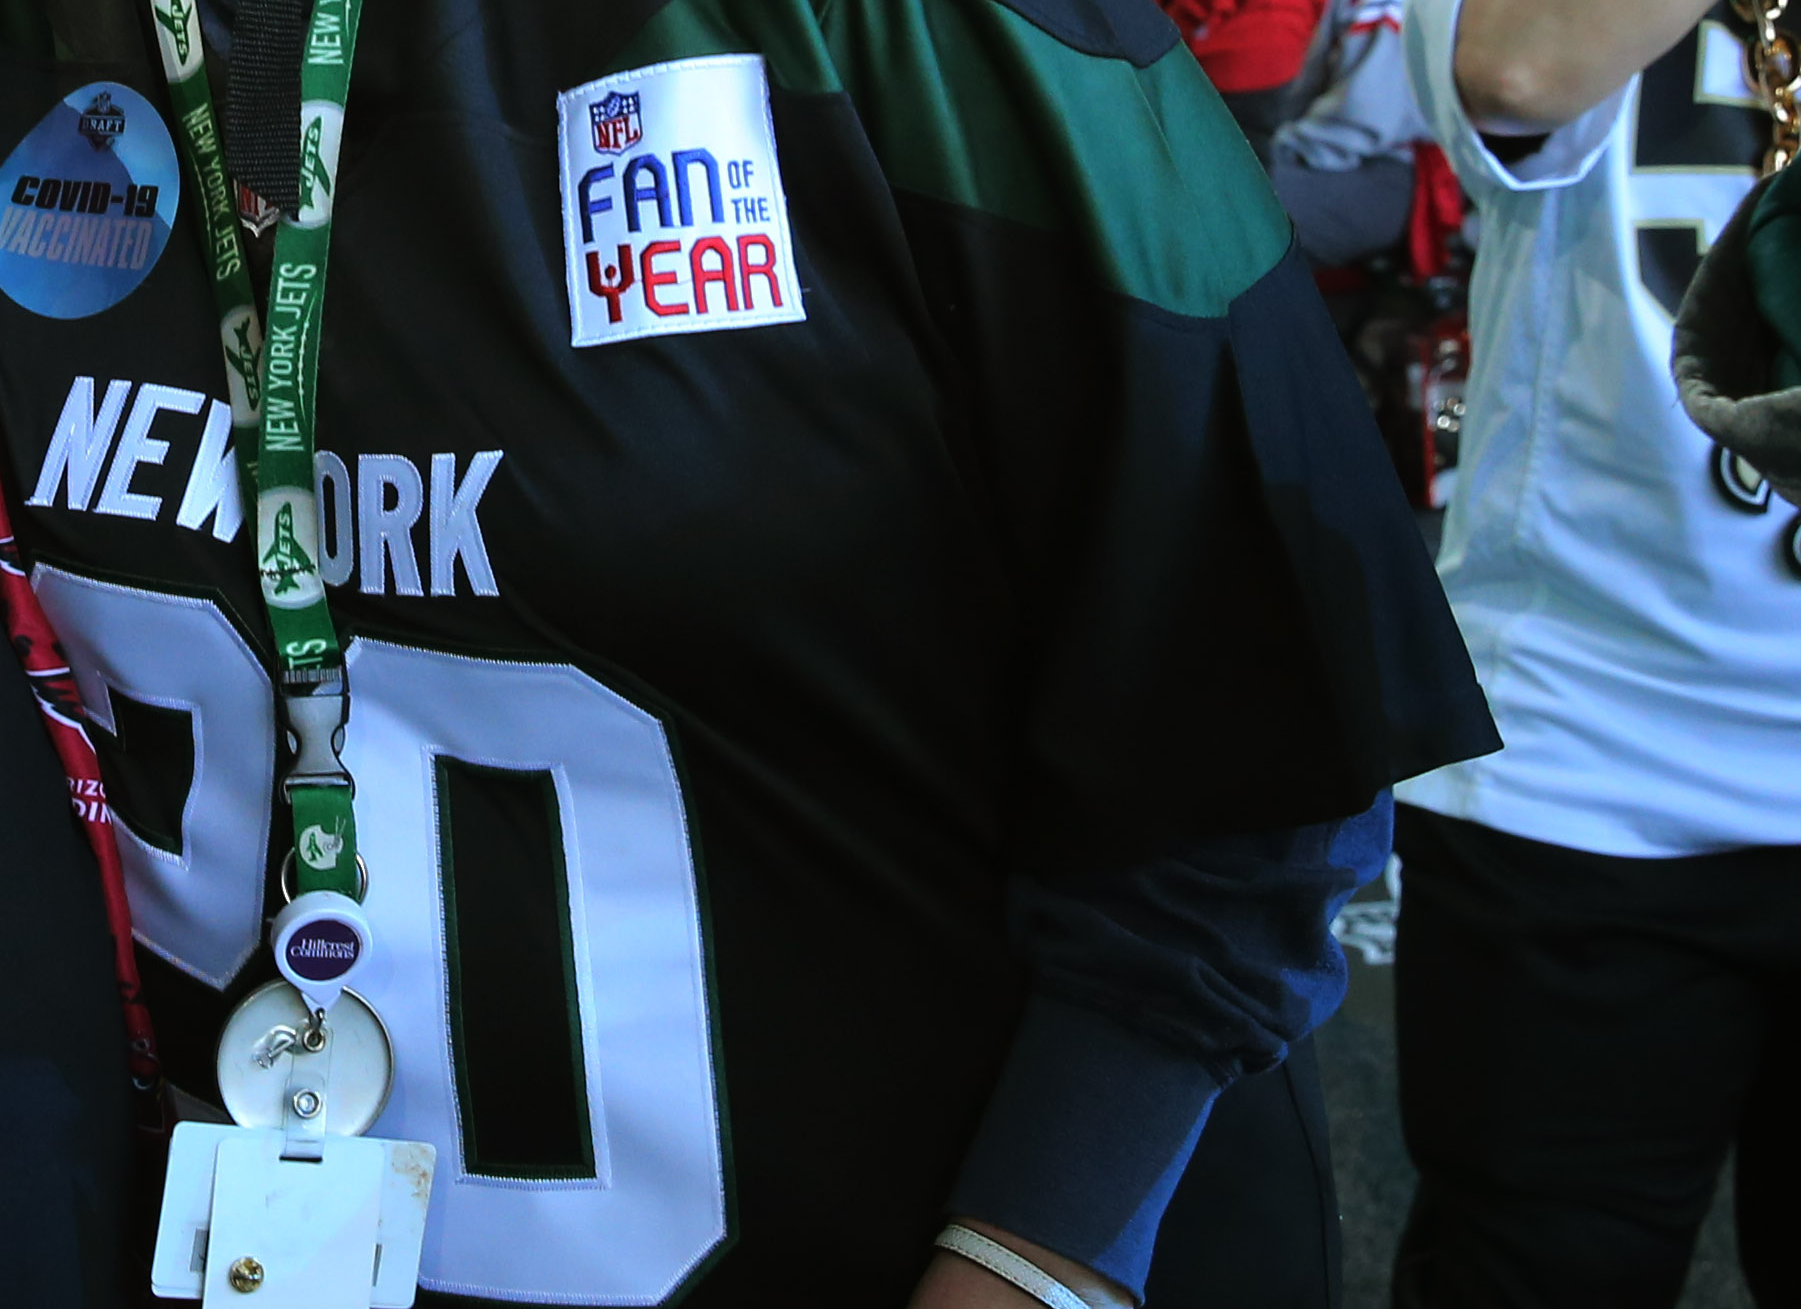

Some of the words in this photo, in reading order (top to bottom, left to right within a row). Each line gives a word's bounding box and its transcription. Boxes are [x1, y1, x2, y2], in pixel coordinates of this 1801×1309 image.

[171, 3, 190, 57] JETS
[308, 11, 345, 66] NEW
[81, 117, 125, 132] DRAFT
[182, 102, 213, 155] NEW
[595, 116, 640, 150] NFL
[304, 125, 322, 189] JETS
[11, 174, 159, 219] COVID-19
[206, 155, 231, 223] YORK
[577, 147, 726, 244] FAN
[726, 159, 755, 189] OF
[730, 196, 771, 225] THE
[214, 225, 242, 281] JETS
[586, 232, 784, 324] YEAR
[274, 261, 318, 321] JETS
[239, 344, 260, 403] JETS
[266, 325, 299, 395] YORK
[265, 397, 305, 452] NEW
[276, 510, 293, 567] JETS
[312, 449, 505, 598] ORK
[289, 944, 355, 959] Commons
[301, 938, 355, 952] Hillcrest
